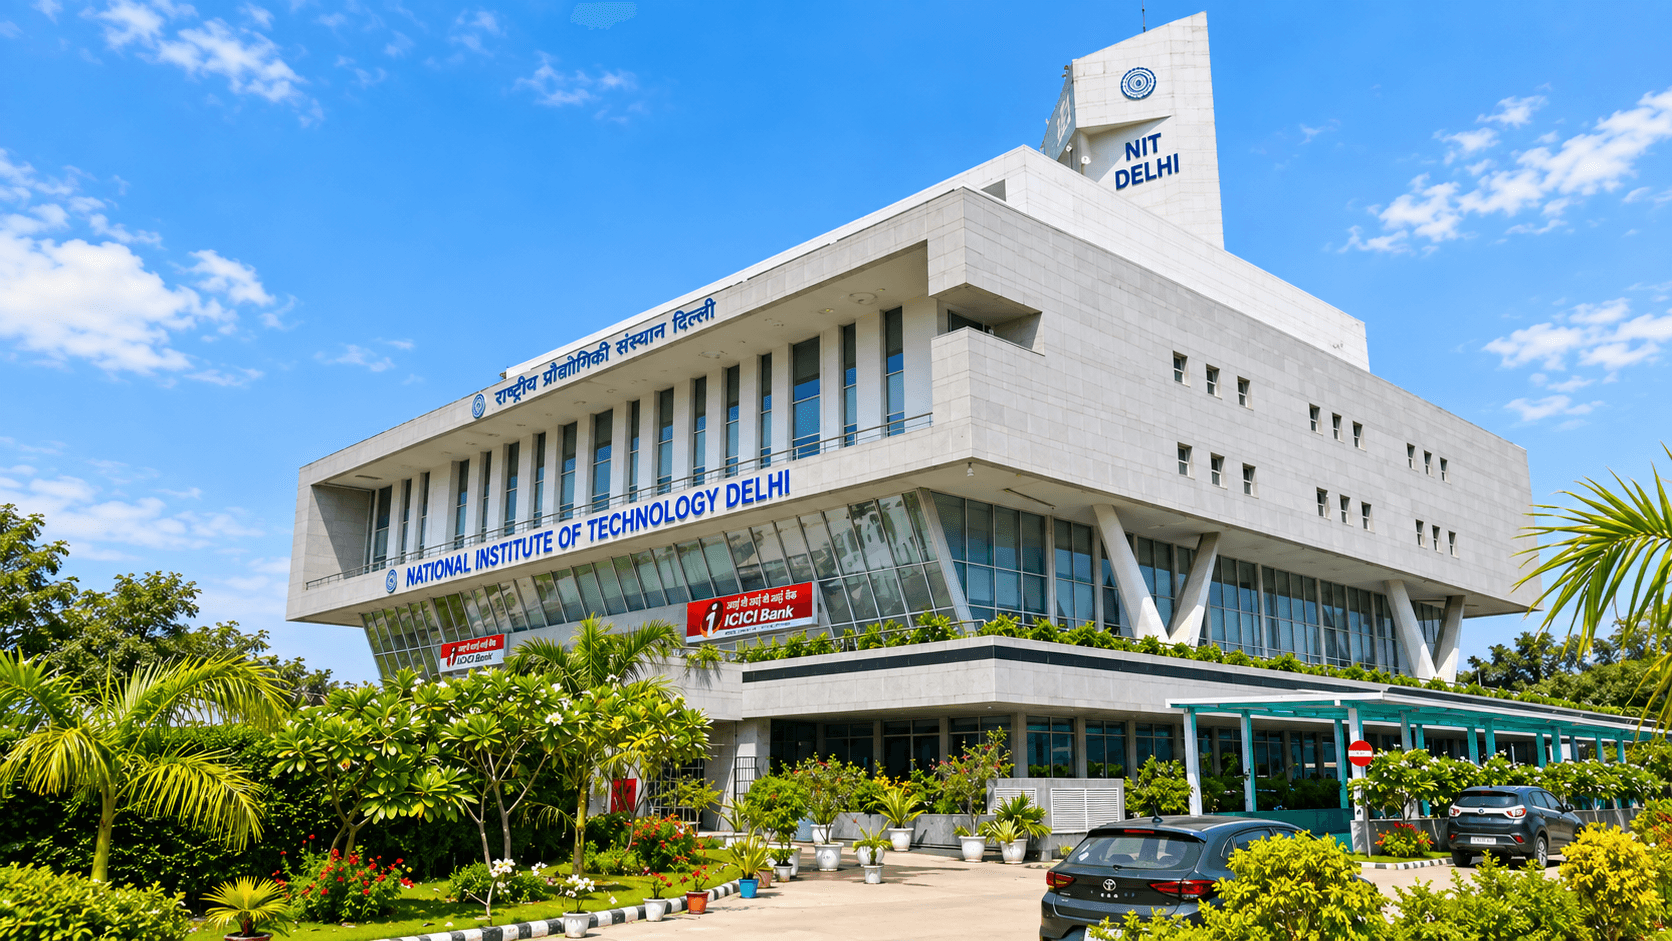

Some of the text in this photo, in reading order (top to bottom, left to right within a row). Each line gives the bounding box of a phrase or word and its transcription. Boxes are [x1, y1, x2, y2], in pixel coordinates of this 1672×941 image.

[1125, 133, 1161, 161] NIT
[1115, 153, 1179, 190] DELHI
[495, 375, 539, 405] राष्ट्रीय
[672, 297, 716, 334] दिल्ली
[406, 469, 790, 587] NATIONAL INSTITUTE OF TECHNOLOGY DELHI
[724, 605, 794, 627] ICICI Bank
